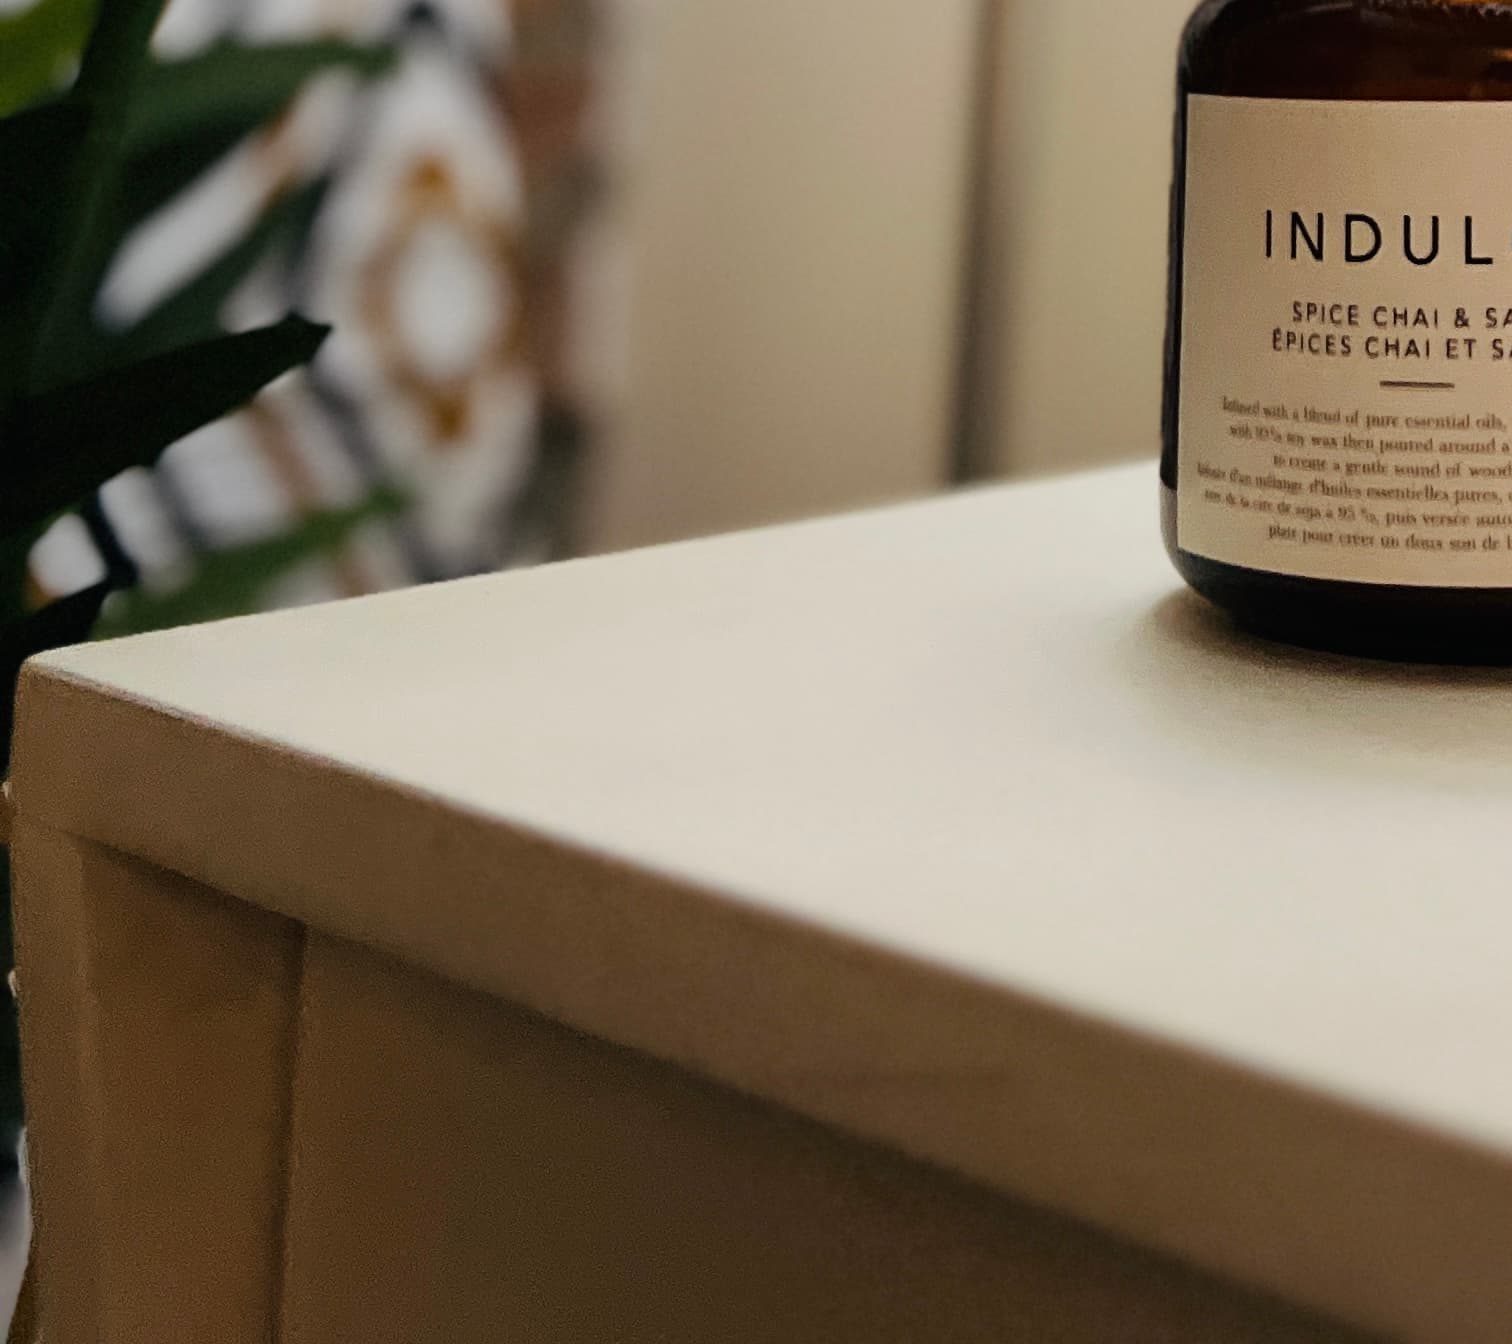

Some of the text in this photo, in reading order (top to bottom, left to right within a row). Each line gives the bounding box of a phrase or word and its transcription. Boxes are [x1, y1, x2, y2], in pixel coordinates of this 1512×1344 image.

[1291, 300, 1360, 327] SPICE
[1373, 305, 1439, 330] CHAI
[1454, 307, 1469, 329] &
[1271, 326, 1353, 357] ÉPICES
[1364, 335, 1431, 359] CHAI
[1446, 336, 1477, 360] ET
[1366, 414, 1399, 430] pure
[1405, 413, 1470, 429] essential
[1343, 432, 1374, 449] then
[1380, 438, 1433, 454] poured
[1439, 438, 1496, 454] around
[1501, 442, 1509, 453] a
[1394, 462, 1440, 477] sound
[1446, 462, 1461, 477] of
[1469, 460, 1512, 477] wood
